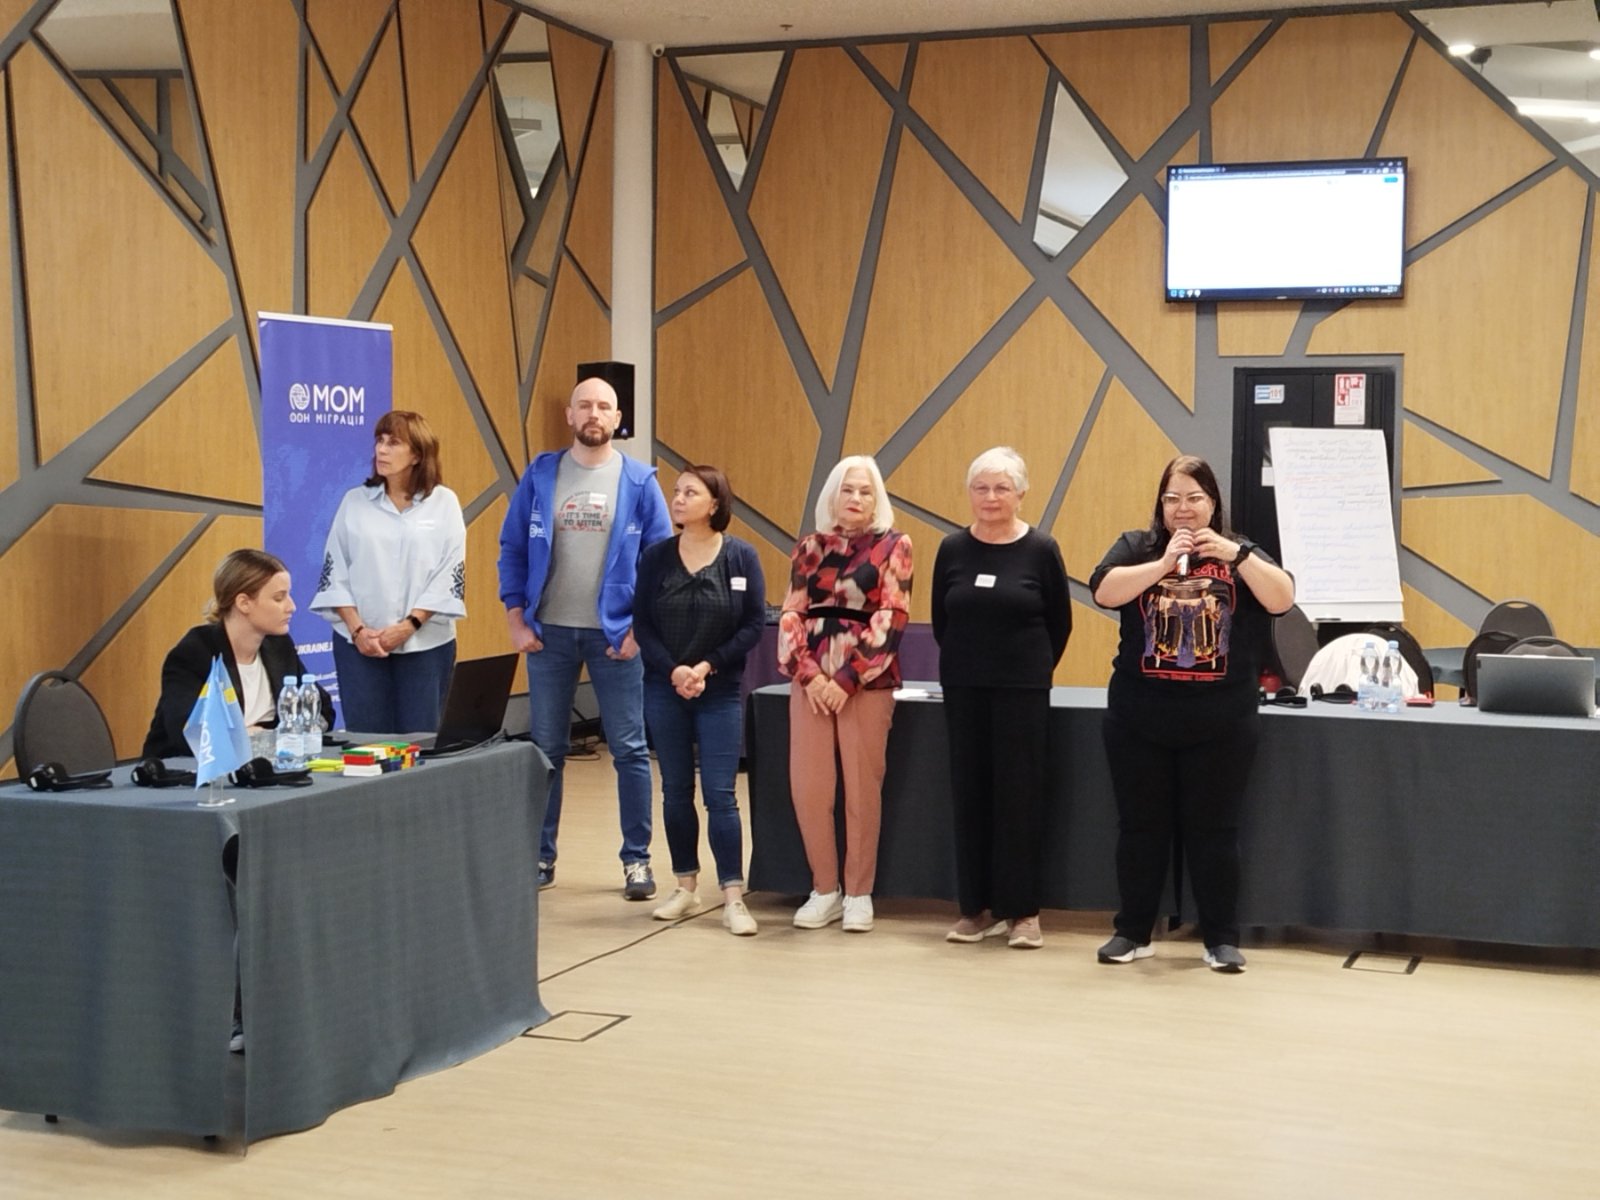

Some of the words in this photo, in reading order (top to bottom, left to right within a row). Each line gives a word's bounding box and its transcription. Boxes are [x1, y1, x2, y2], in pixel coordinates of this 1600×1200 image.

[313, 384, 365, 413] МОМ
[289, 412, 310, 423] ООН
[315, 413, 365, 426] МІГРАЦІЯ
[566, 511, 580, 520] IT'S
[582, 512, 601, 520] TIME
